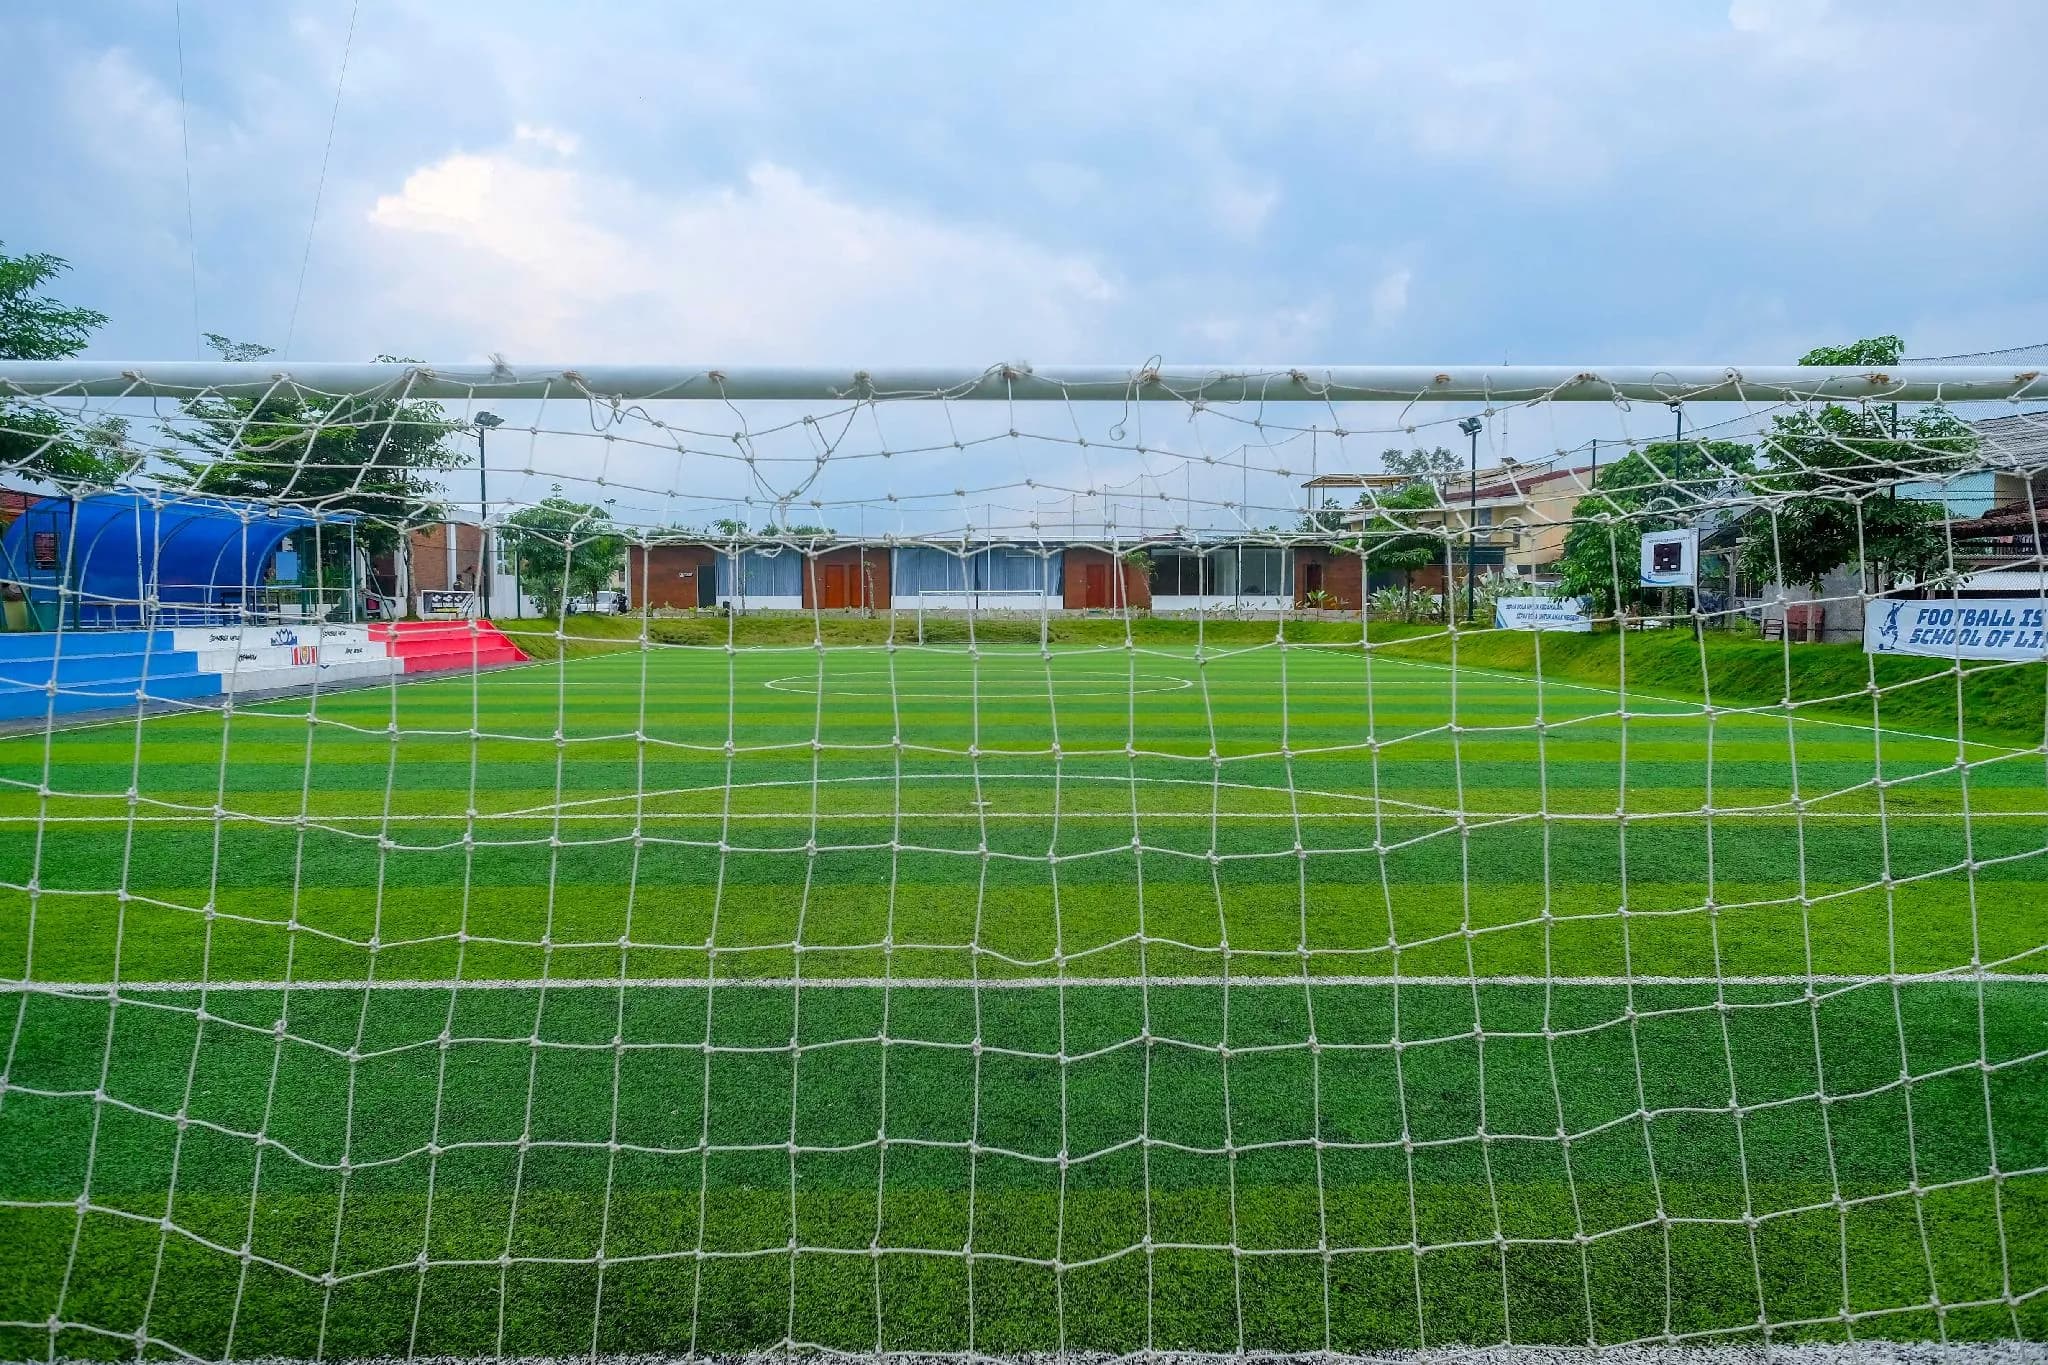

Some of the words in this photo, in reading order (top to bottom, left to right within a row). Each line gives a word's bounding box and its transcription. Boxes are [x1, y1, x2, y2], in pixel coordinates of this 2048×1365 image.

[1917, 608, 2015, 626] FOOTBALL
[2019, 608, 2047, 627] IS
[1909, 628, 1982, 646] SCHOOL
[1985, 629, 2015, 647] OF
